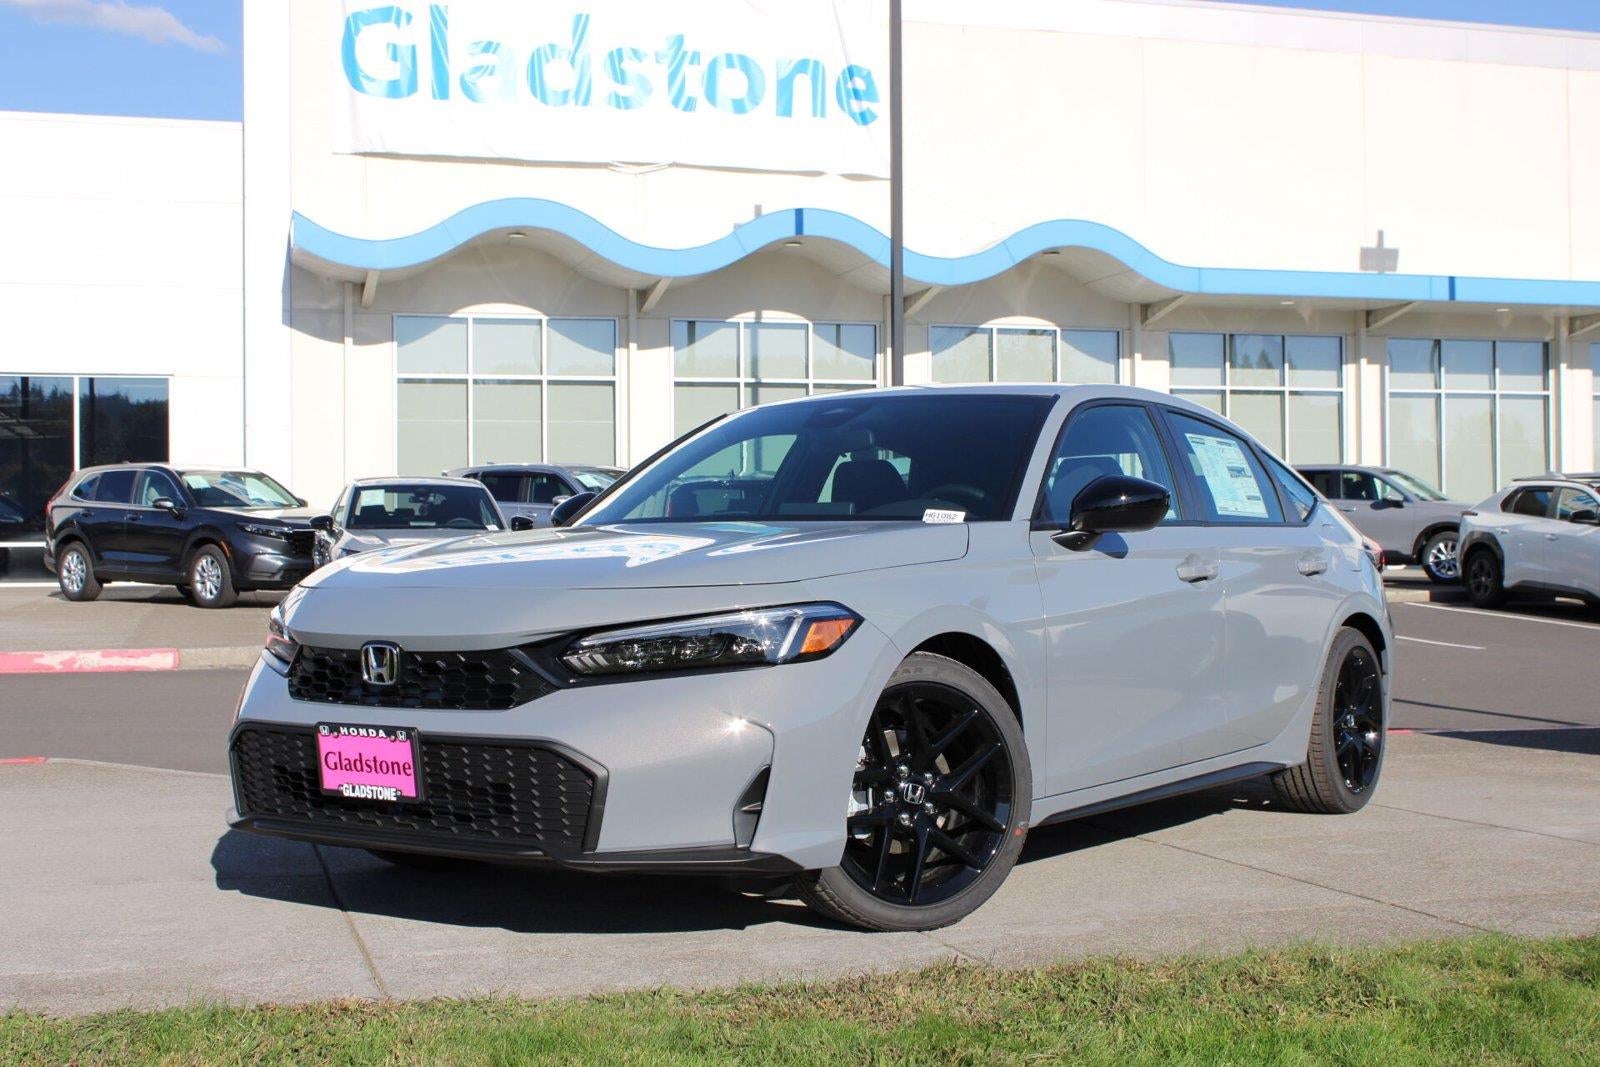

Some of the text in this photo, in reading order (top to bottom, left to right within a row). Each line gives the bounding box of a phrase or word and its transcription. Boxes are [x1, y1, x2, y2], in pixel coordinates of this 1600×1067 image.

[341, 4, 881, 126] Gladstone
[340, 727, 387, 738] HONDA
[324, 751, 412, 776] Gladstone
[342, 783, 398, 801] GLADSTONE
